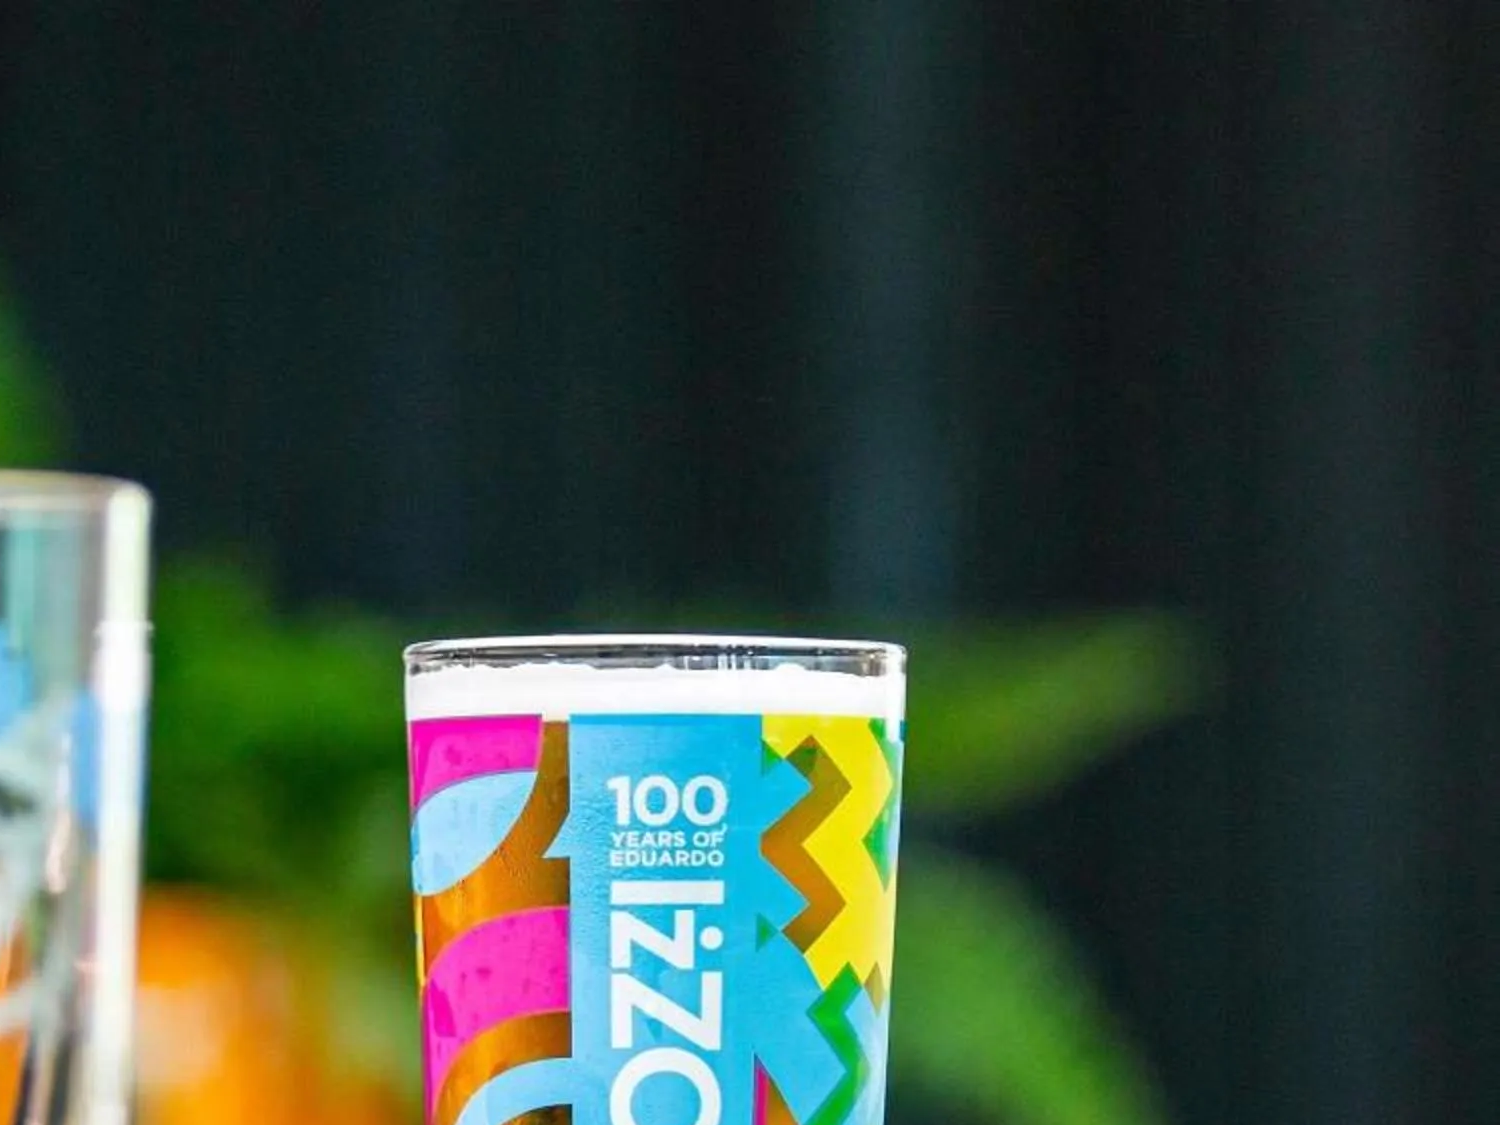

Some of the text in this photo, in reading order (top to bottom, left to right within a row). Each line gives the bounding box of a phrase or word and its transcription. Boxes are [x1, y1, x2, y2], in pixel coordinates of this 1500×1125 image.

[606, 774, 729, 827] 100
[610, 831, 725, 848] YEARS OF
[609, 850, 725, 867] EDUARDO
